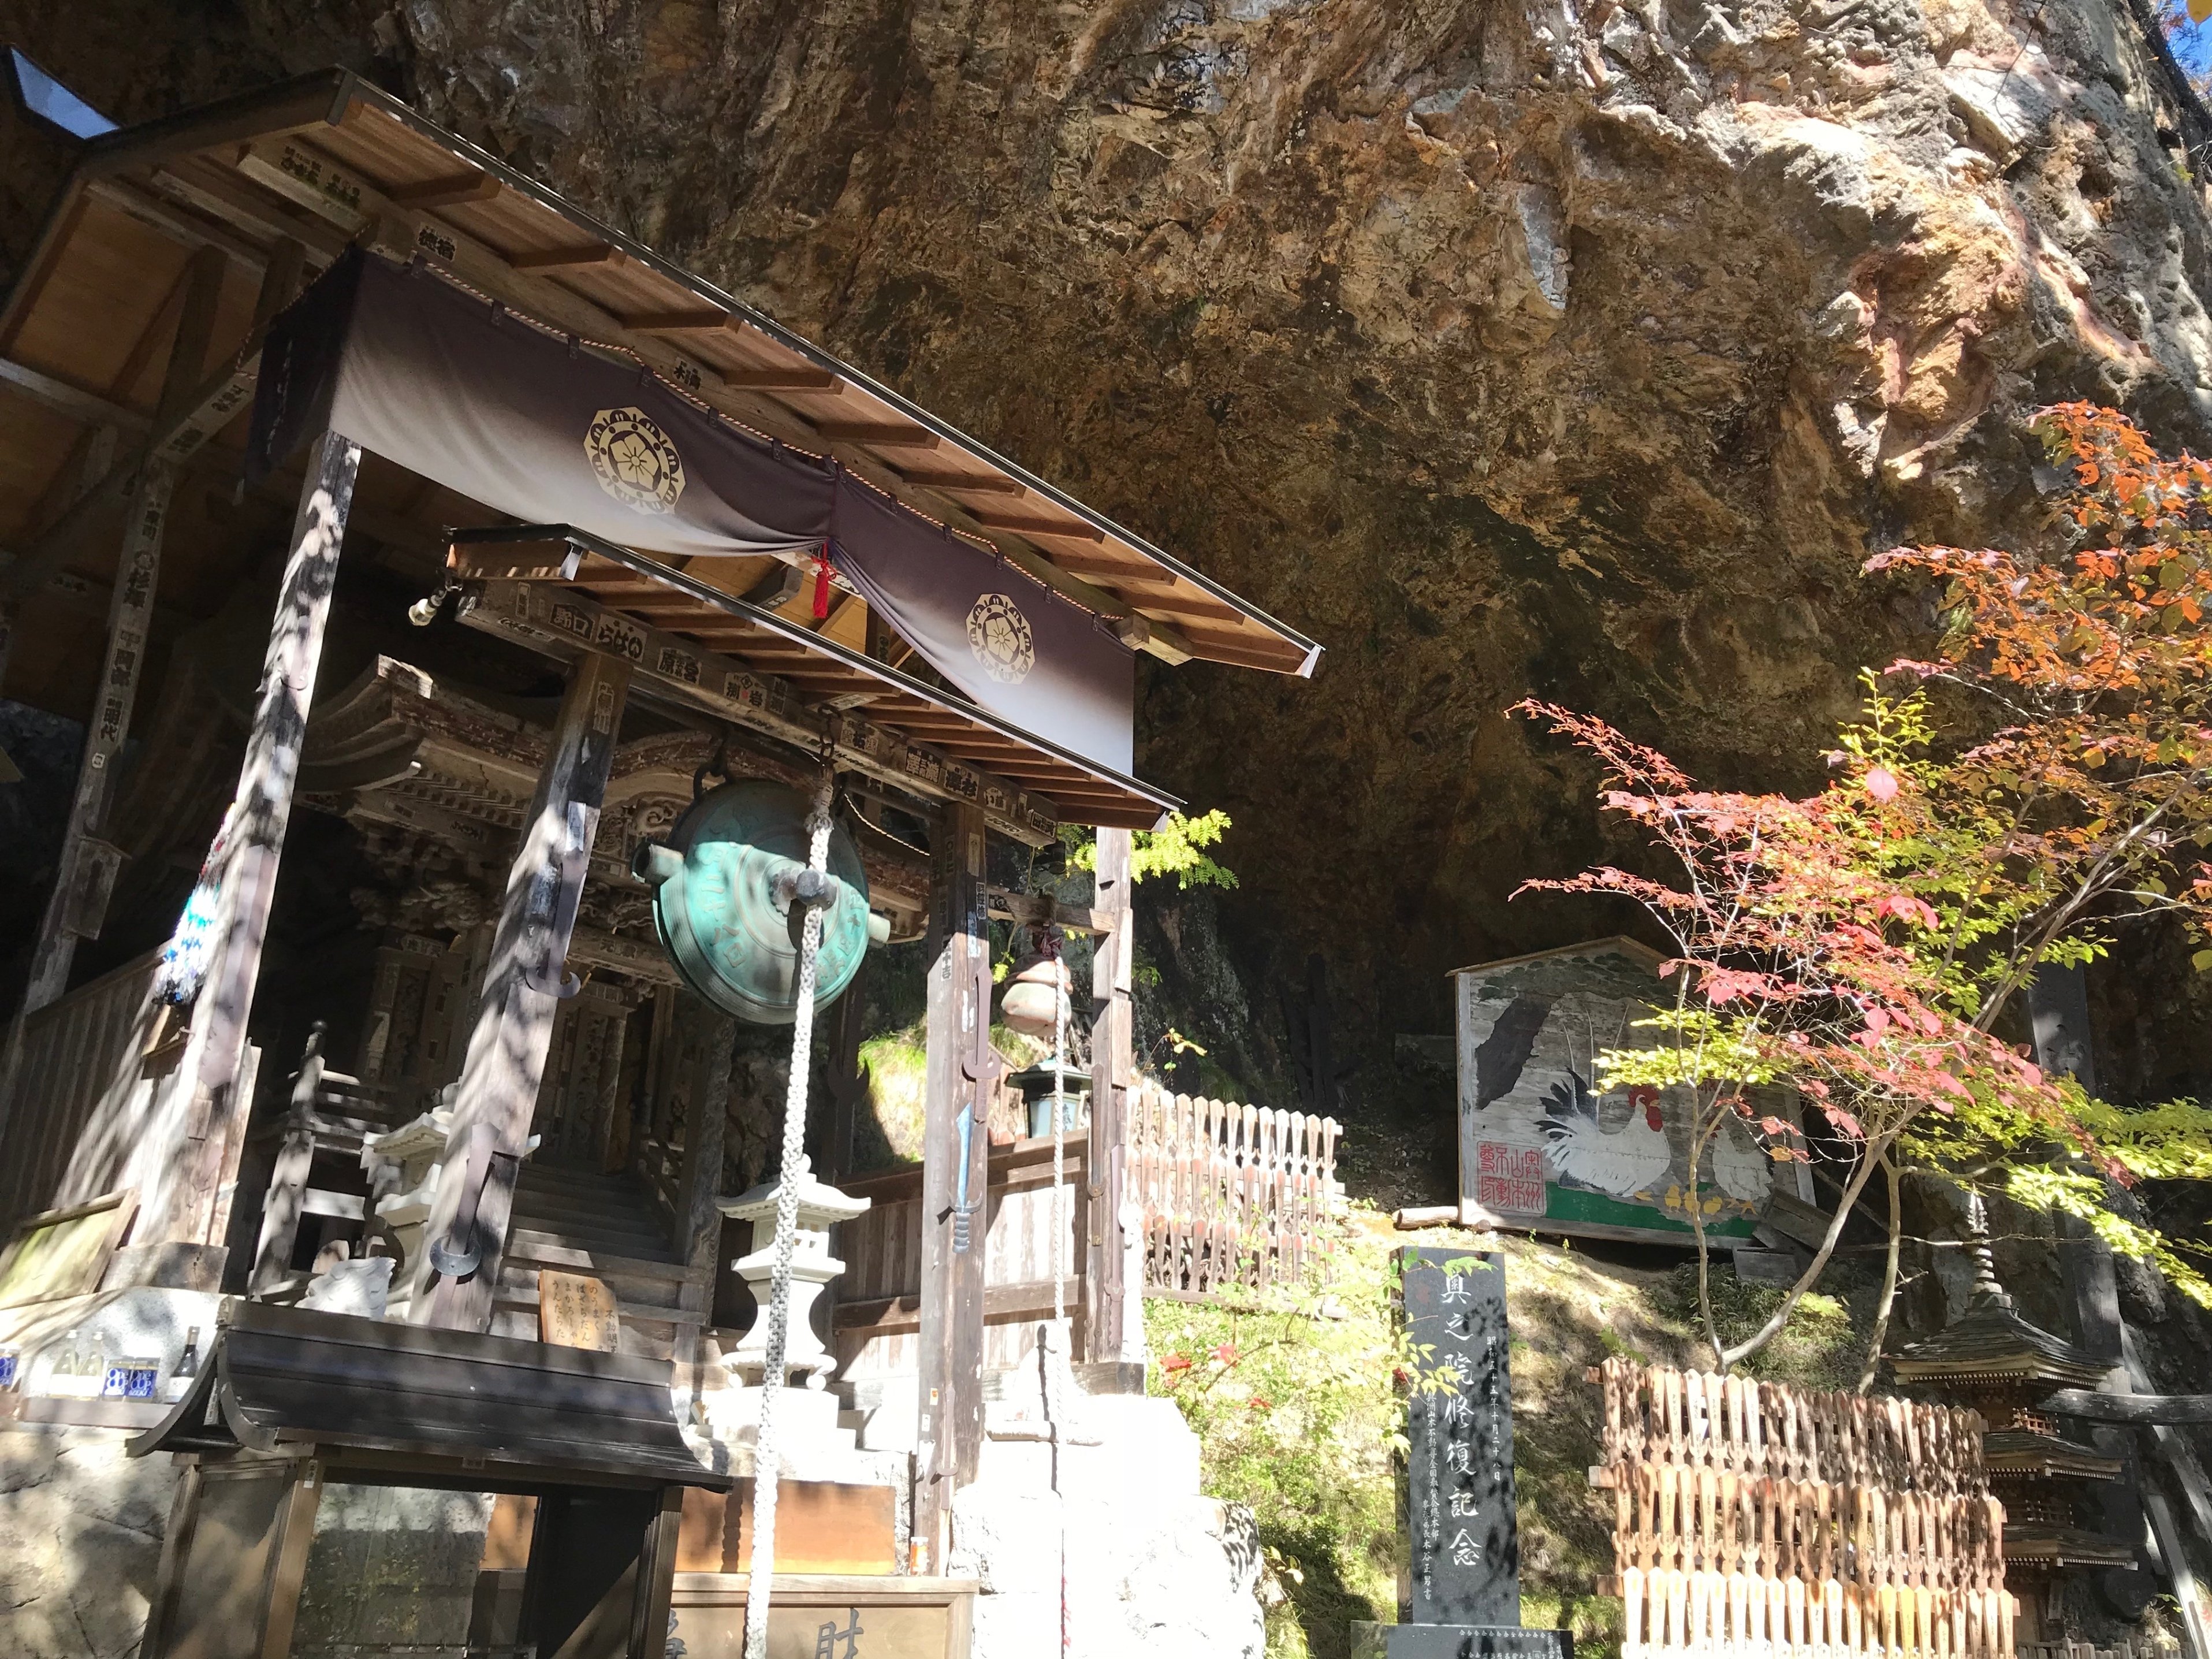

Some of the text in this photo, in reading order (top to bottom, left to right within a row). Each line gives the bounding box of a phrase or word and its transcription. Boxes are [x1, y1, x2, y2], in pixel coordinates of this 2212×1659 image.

[1486, 1336, 1502, 1481] 昭和五十五年十月二十八日
